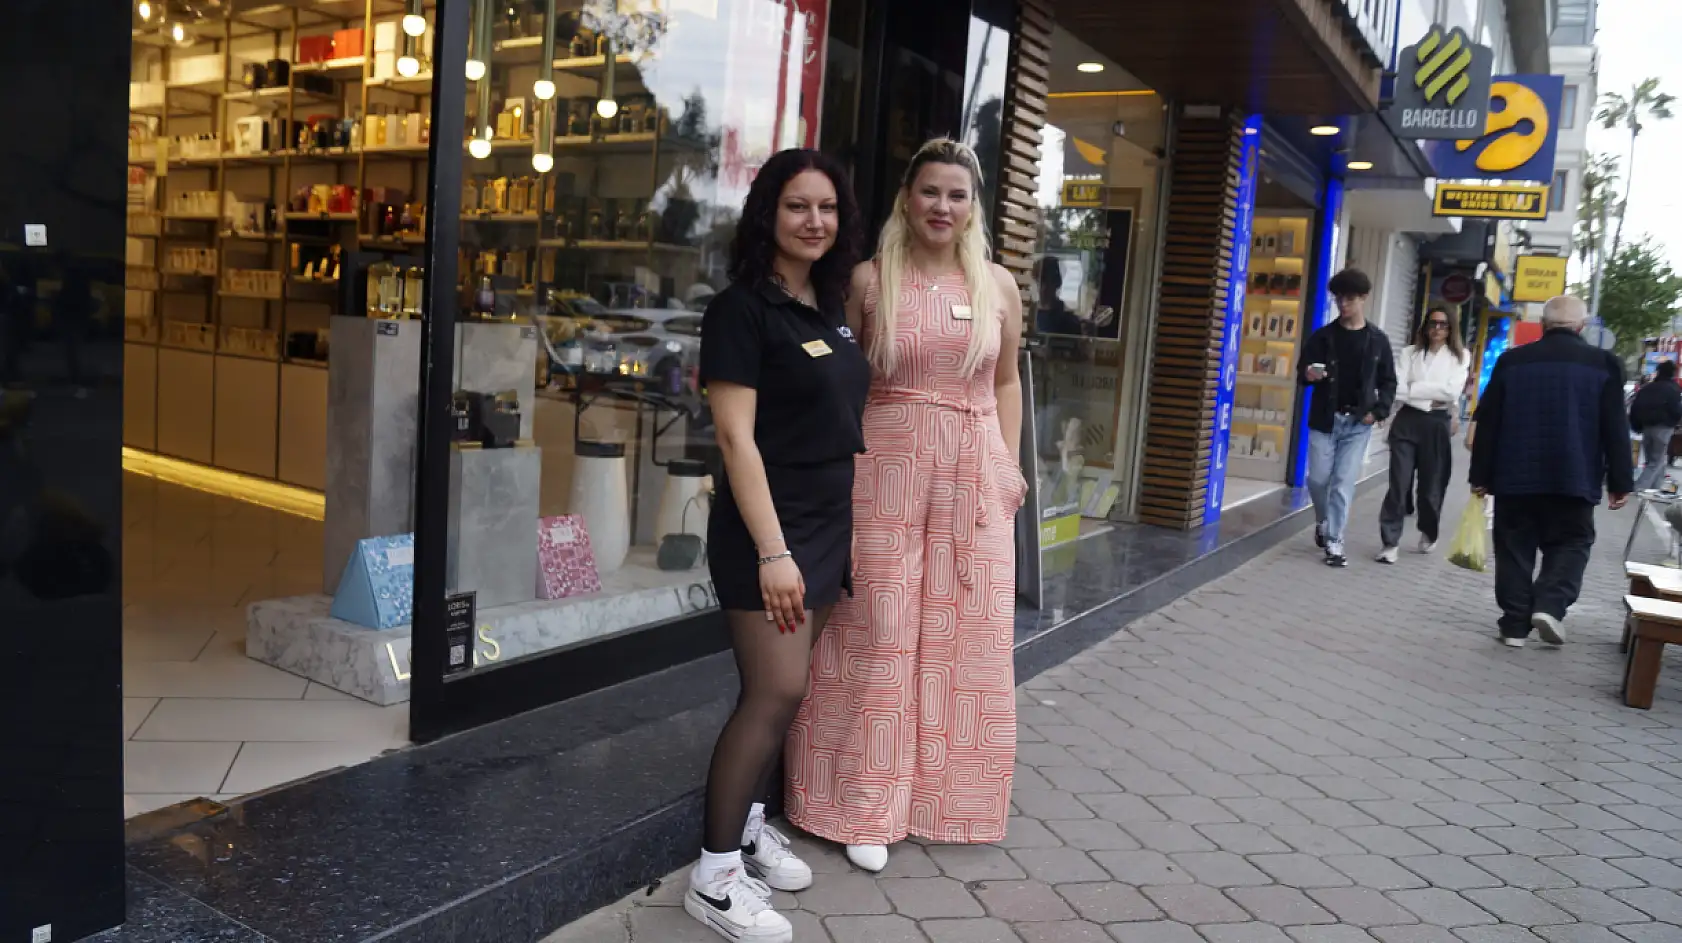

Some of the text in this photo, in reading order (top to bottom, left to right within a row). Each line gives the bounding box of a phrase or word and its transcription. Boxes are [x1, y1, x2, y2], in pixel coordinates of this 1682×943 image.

[1402, 108, 1478, 129] BARGELLO
[1446, 191, 1498, 201] WESTERN
[1460, 200, 1496, 209] UNION
[1212, 201, 1252, 508] TURKCELL
